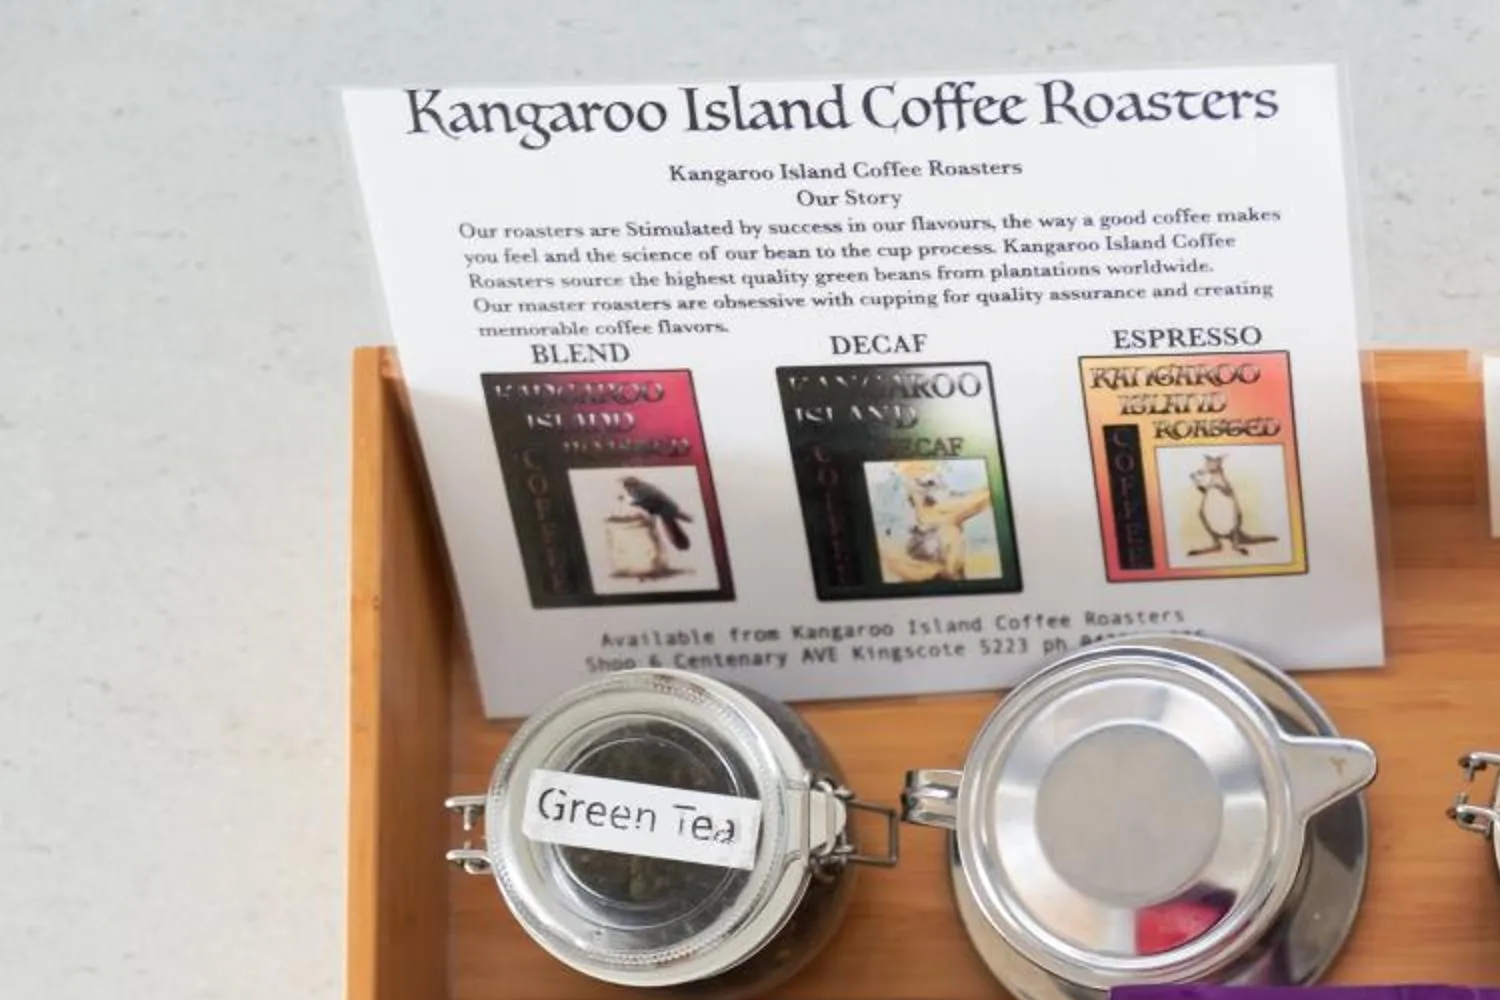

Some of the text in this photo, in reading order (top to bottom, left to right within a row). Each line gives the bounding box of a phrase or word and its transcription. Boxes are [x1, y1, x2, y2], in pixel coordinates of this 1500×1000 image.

[404, 79, 1279, 151] Kangaroo Island Coffee Roasters
[668, 159, 1023, 186] Kangaroo Island Coffee Roasters
[796, 189, 902, 209] Our Story
[458, 222, 498, 239] Our
[503, 226, 585, 239] roasters
[589, 226, 621, 238] are
[625, 219, 735, 237] Stimulated
[738, 219, 763, 238] by
[767, 222, 844, 235] success
[847, 217, 867, 233] in
[872, 221, 906, 233] our
[1001, 212, 1033, 230] the
[1037, 216, 1078, 231] way
[1082, 216, 1095, 227] a
[1099, 209, 1147, 231] good
[1151, 207, 1211, 225] coffee
[1216, 206, 1281, 223] makes
[463, 253, 499, 268] you
[503, 247, 539, 264] feel
[544, 247, 581, 264] and
[585, 247, 616, 263] the
[621, 246, 693, 263] science
[697, 244, 720, 261] of
[724, 248, 759, 261] our
[762, 243, 812, 261] bean
[815, 246, 836, 260] to
[840, 241, 871, 259] the
[876, 246, 913, 260] cup
[1002, 237, 1101, 257] Kangaroo
[1104, 233, 1167, 251] Island
[1171, 232, 1236, 249] Coffee
[468, 257, 1214, 289] Roasters source the highest quality green beans from plantations worldwide.
[473, 281, 1274, 313] Our master roasters are obsessive with cupping for quality assurance and creating
[478, 321, 589, 337] memorable
[594, 319, 653, 336] coffee
[1114, 326, 1262, 349] ESPRESSO
[531, 343, 630, 364] BLEND
[830, 334, 927, 354] DECAF
[889, 437, 964, 458] ECAF
[674, 649, 788, 670] Centenary
[802, 647, 838, 664] AVE
[852, 641, 966, 665] Kingscote
[980, 638, 1028, 655] 5223
[1043, 636, 1068, 655] ph
[537, 787, 735, 844] Green Tea
